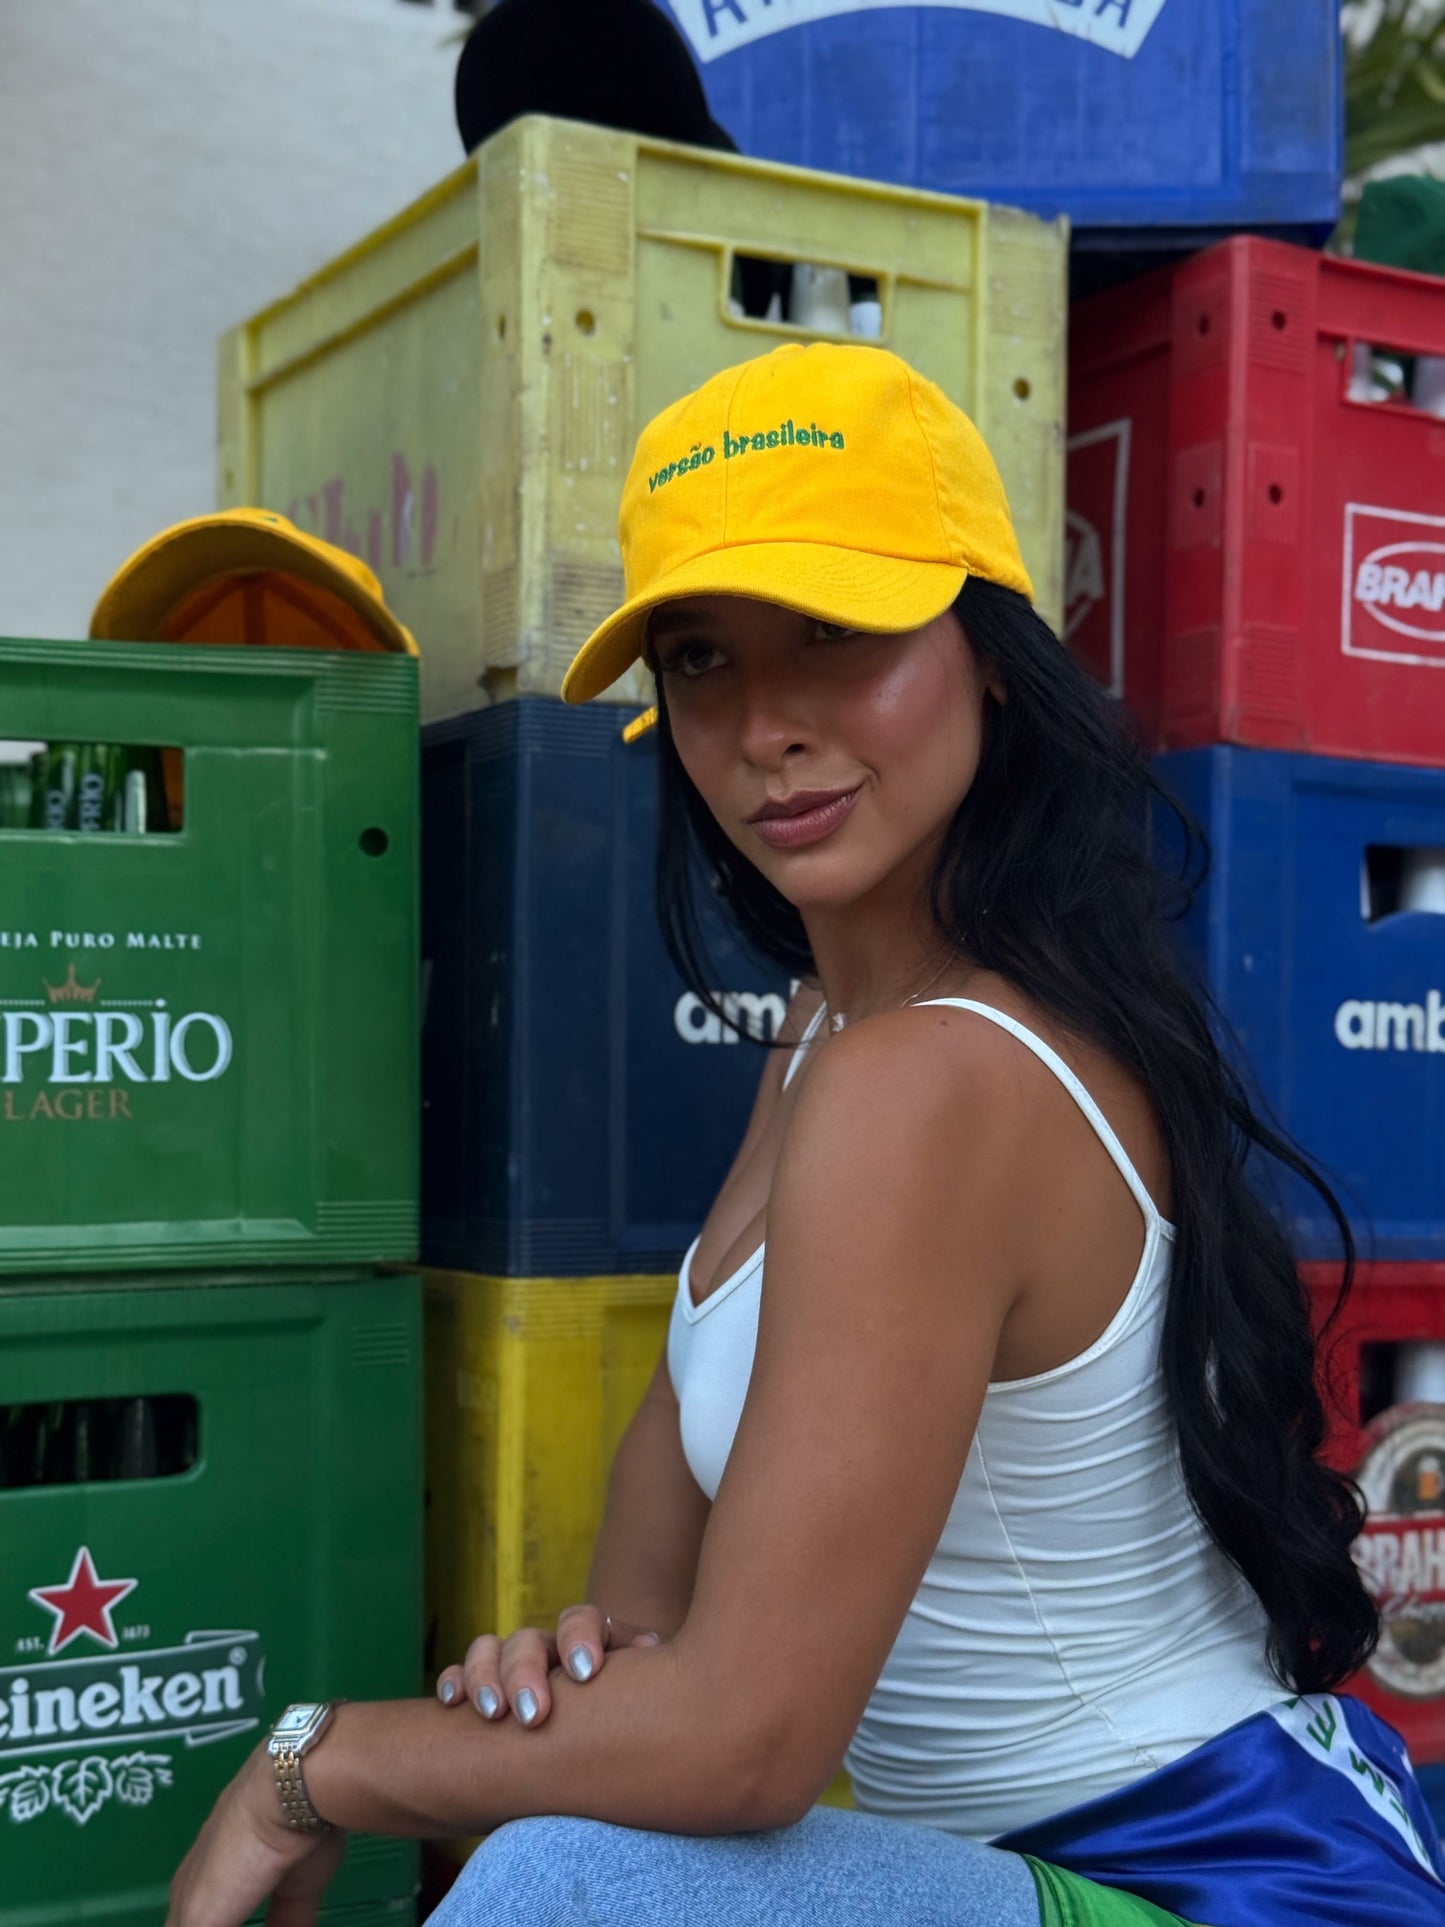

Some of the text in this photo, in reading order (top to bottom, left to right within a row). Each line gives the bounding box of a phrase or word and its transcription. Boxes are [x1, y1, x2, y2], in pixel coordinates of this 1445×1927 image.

[648, 419, 845, 494] versão brasileira
[51, 930, 115, 948] PURO
[126, 932, 201, 949] MALTE
[674, 978, 802, 1044] am
[3, 1088, 133, 1121] LAGER
[0, 1665, 244, 1739] ineken
